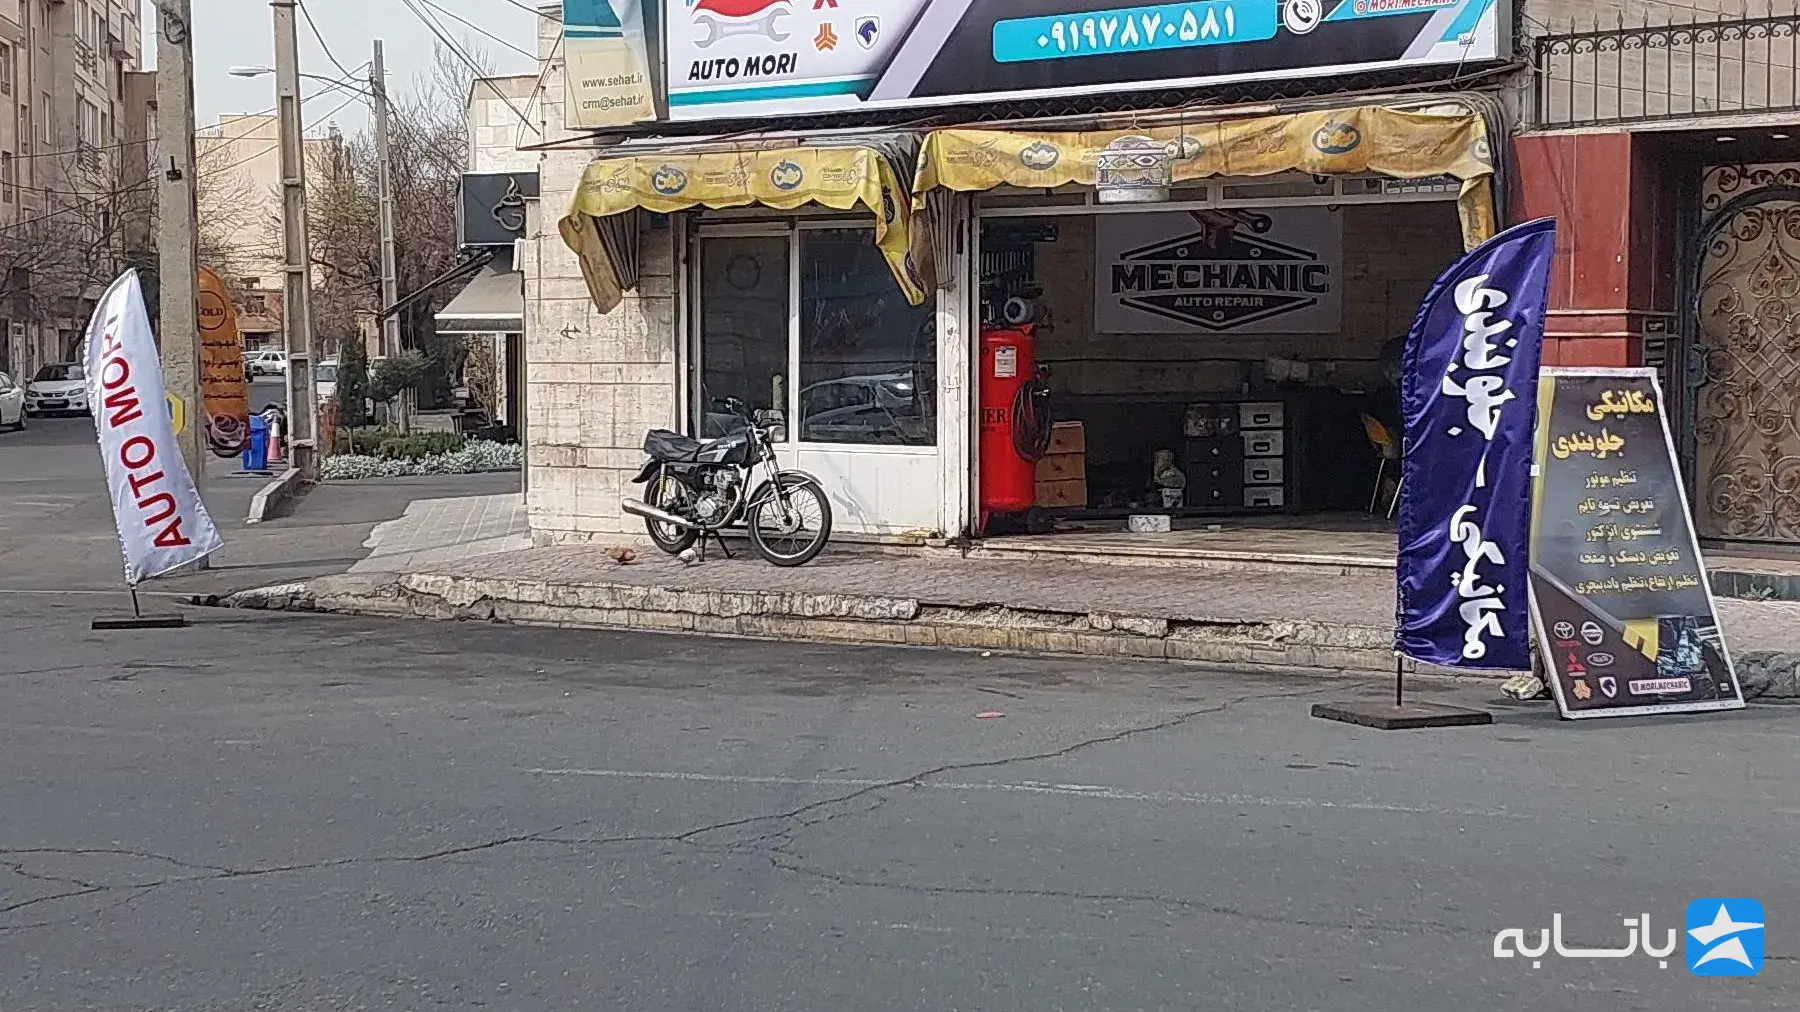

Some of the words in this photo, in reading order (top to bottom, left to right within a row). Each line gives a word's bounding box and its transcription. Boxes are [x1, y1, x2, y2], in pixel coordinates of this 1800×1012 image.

[1369, 0, 1457, 11] MORI.MECH
[1037, 5, 1235, 52] ۰۹۱۹۷۸۷۰۵۸۱
[688, 57, 740, 81] AUTO
[744, 53, 797, 76] MORI
[582, 73, 643, 88] www.sehat.ir
[582, 94, 644, 110] crm@sehat.ir
[1112, 263, 1329, 294] MECHANIC
[1174, 297, 1213, 307] AUTO
[1214, 296, 1264, 307] REPAIR
[200, 307, 223, 316] OLD
[1442, 274, 1516, 441] جلوبندی
[1586, 390, 1655, 421] مکانیکی
[1552, 427, 1625, 459] جلوبندی
[1585, 470, 1610, 488] موتور
[1612, 469, 1637, 487] تنظیم
[120, 435, 191, 548] AUTO
[1578, 497, 1596, 514] تایم
[1623, 496, 1655, 514] تعویض
[1579, 552, 1606, 564] صفحه
[1616, 549, 1646, 565] دیسک
[1649, 548, 1680, 565] تعویض
[1449, 504, 1506, 660] مکانیکی
[1675, 574, 1699, 589] تنظیم
